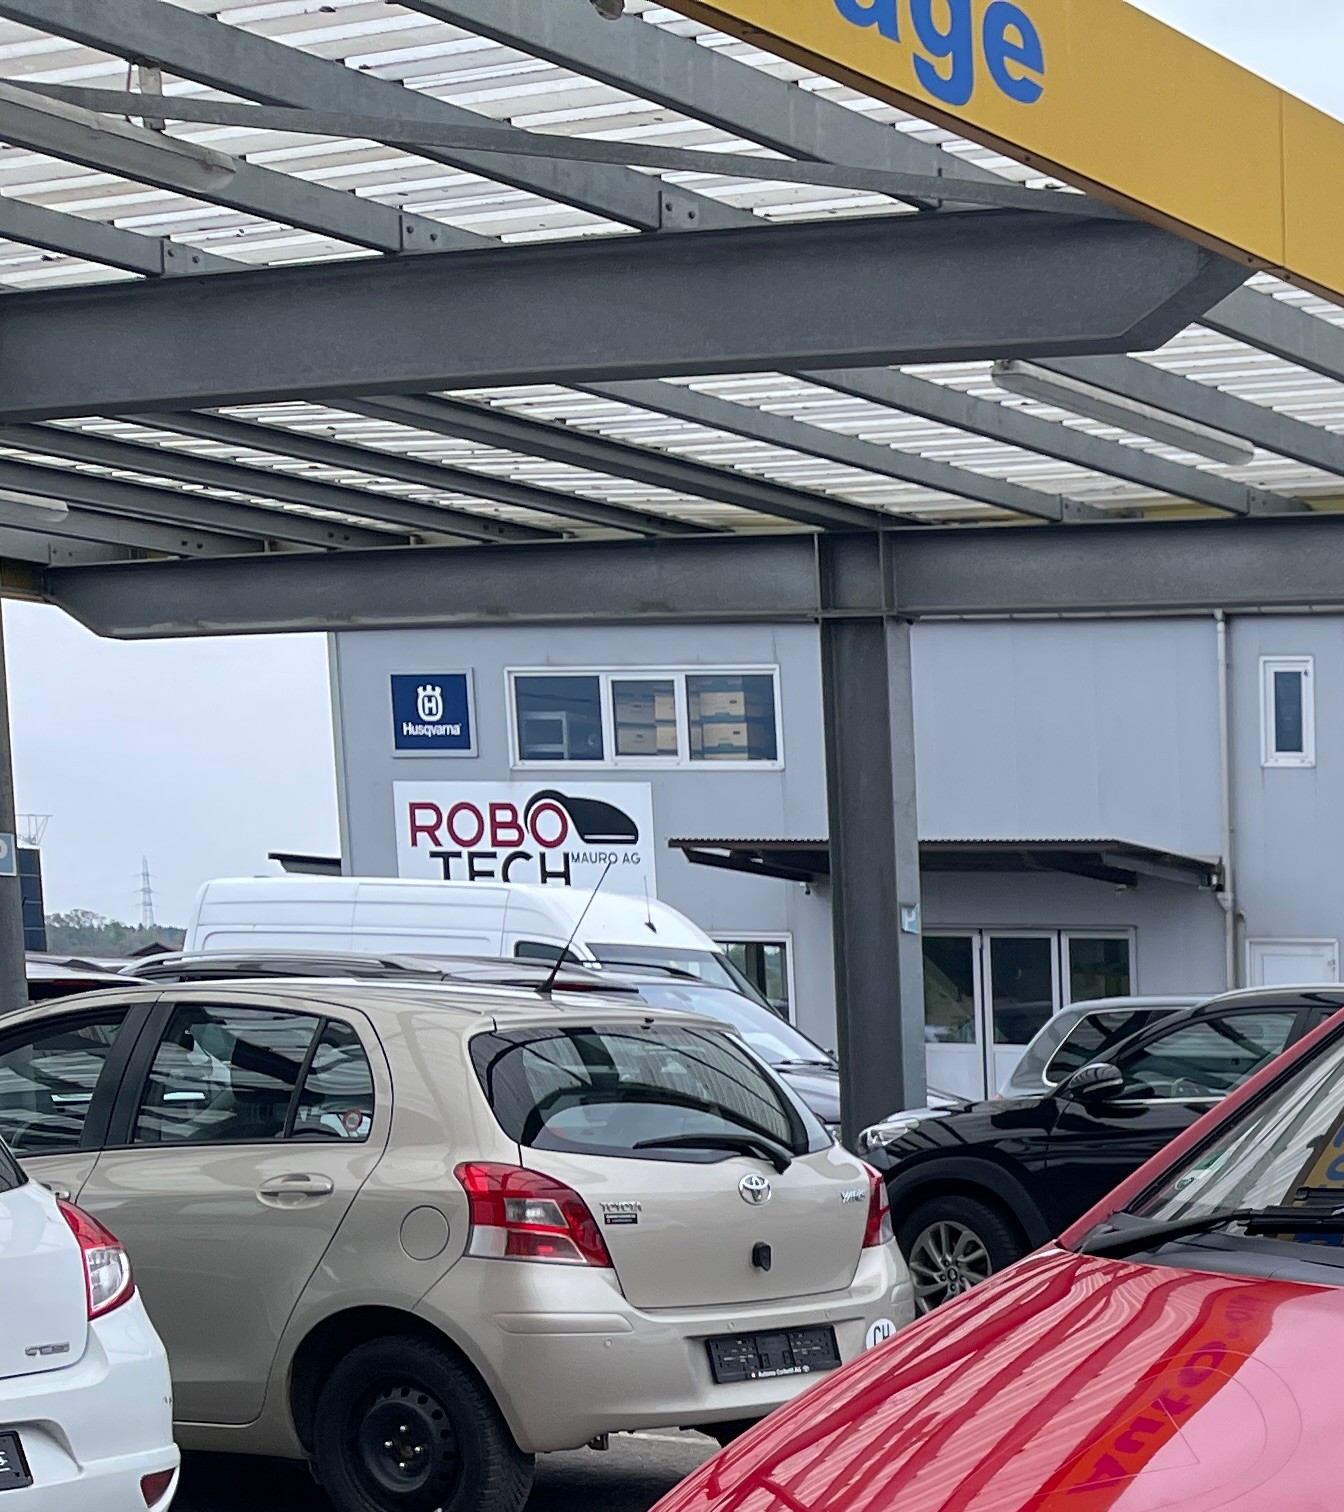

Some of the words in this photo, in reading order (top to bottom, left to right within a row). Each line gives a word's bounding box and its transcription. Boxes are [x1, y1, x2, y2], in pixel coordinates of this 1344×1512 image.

[402, 722, 461, 737] Husqvarna
[408, 801, 569, 848] ROBO
[571, 852, 618, 865] MAURO
[622, 852, 641, 865] AG
[873, 1323, 891, 1346] CH
